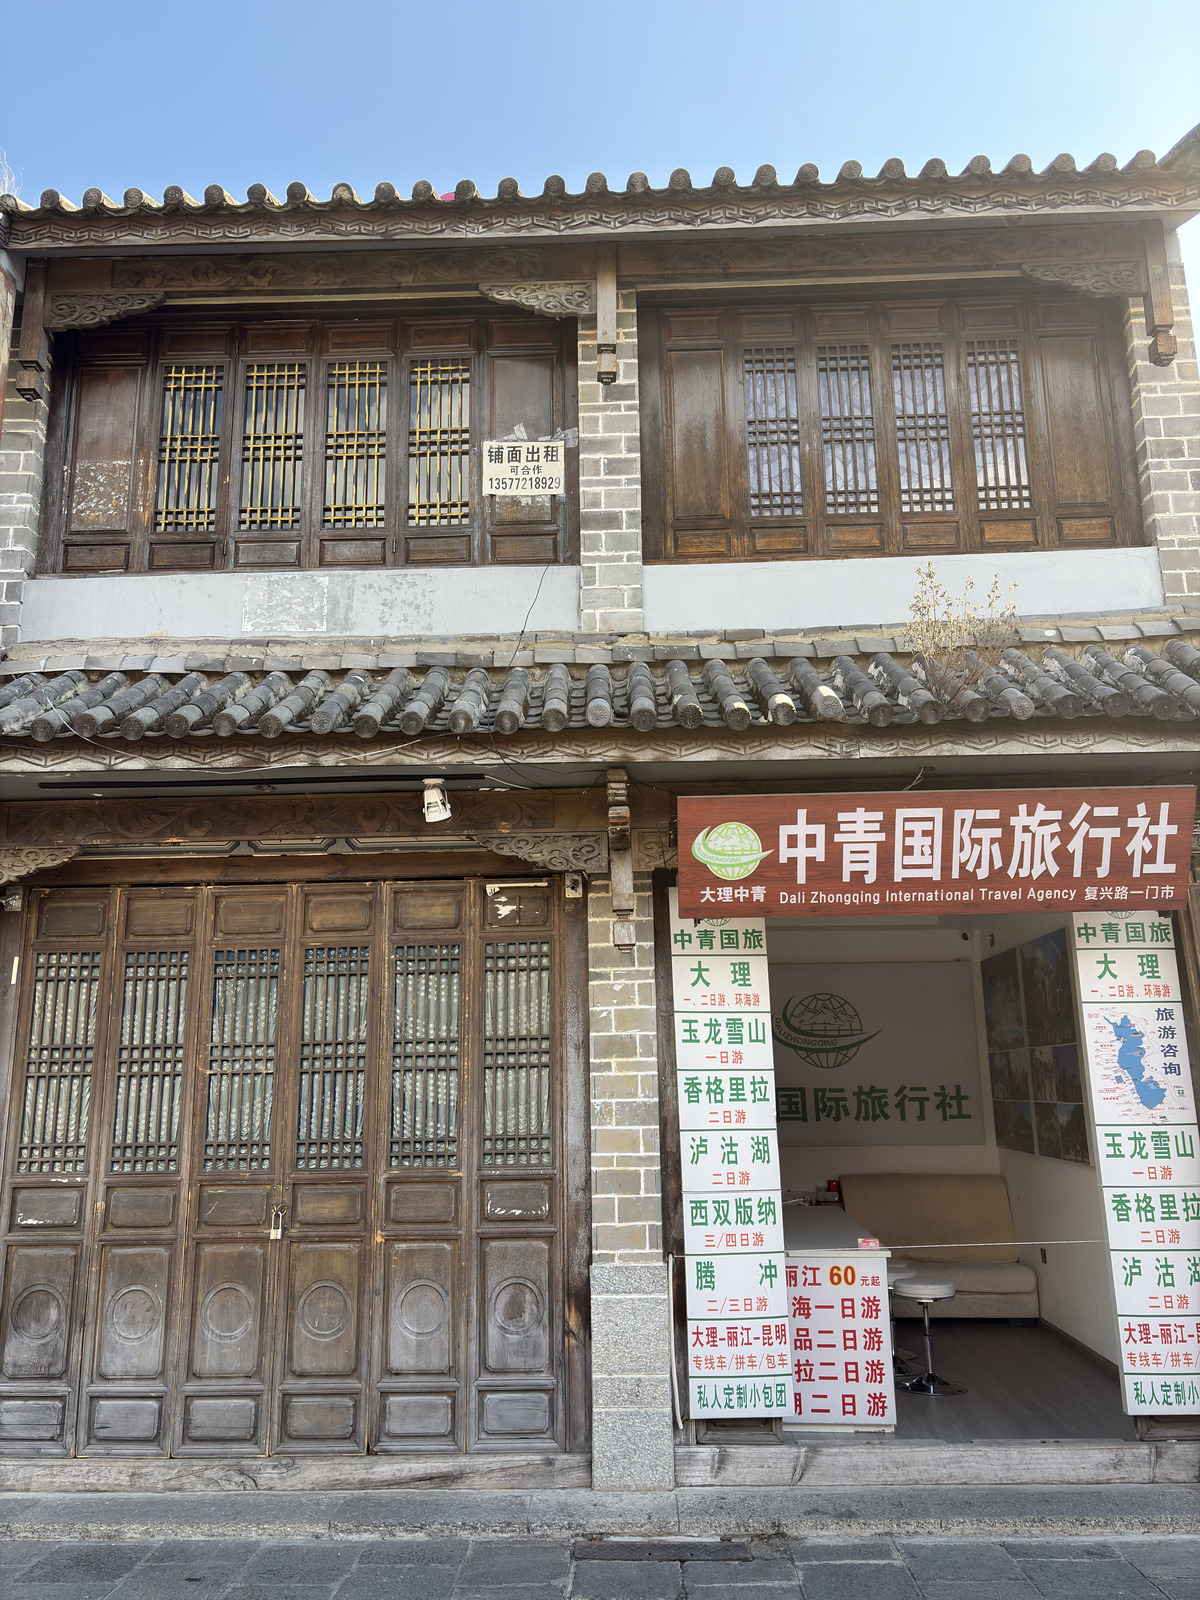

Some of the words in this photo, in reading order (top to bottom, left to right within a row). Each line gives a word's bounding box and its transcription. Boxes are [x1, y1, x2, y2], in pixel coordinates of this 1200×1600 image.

[487, 445, 559, 464] 铺面出租
[510, 465, 542, 475] 可合作
[489, 477, 561, 490] 13577218929
[778, 802, 1179, 884] 中青国际旅行社
[700, 886, 766, 903] 大理中青
[779, 892, 805, 904] Dali
[810, 890, 880, 905] Zhongqing
[886, 889, 974, 902] International
[980, 888, 1022, 900] Travel
[1027, 887, 1077, 901] Agency
[1084, 885, 1175, 900] 复兴路一门市
[673, 929, 764, 950] 中青国旅
[1077, 921, 1173, 944] 中青国旅
[690, 960, 752, 988] 大理
[1096, 953, 1162, 980] 大理
[683, 993, 761, 1007] 一、二日游、环海游
[1090, 984, 1171, 998] 一、二日游、环海游
[681, 1017, 766, 1045] 玉龙雪山
[1155, 1007, 1181, 1077] 旅游咨询
[706, 1050, 744, 1064] 一日游
[683, 1075, 770, 1104] 香格里拉
[776, 1084, 972, 1123] 国际旅行社
[709, 1110, 747, 1124] 二日游
[690, 1135, 771, 1165] 泸沽湖
[1104, 1130, 1195, 1161] 玉龙雪山
[712, 1171, 751, 1186] 二日游
[1132, 1165, 1173, 1181] 一日游
[689, 1196, 777, 1227] 西双版纳
[1112, 1192, 1200, 1223] 香格里拉
[704, 1232, 765, 1248] 三/四日游
[1140, 1229, 1181, 1245] 二日游
[695, 1259, 778, 1291] 腾冲
[829, 1265, 856, 1287] 60
[860, 1275, 880, 1287] 元起
[707, 1296, 768, 1313] 二/三日游
[787, 1295, 881, 1320] 海一日游
[1149, 1294, 1190, 1310] 二日游
[691, 1323, 787, 1348] 大理-丽江-昆明
[794, 1327, 883, 1352] 品二日游
[692, 1352, 788, 1371] 专线车/拼车/包车
[794, 1359, 885, 1384] 拉二日游
[697, 1382, 787, 1410] 私人定制小包团
[1133, 1380, 1200, 1406] 私人定制小
